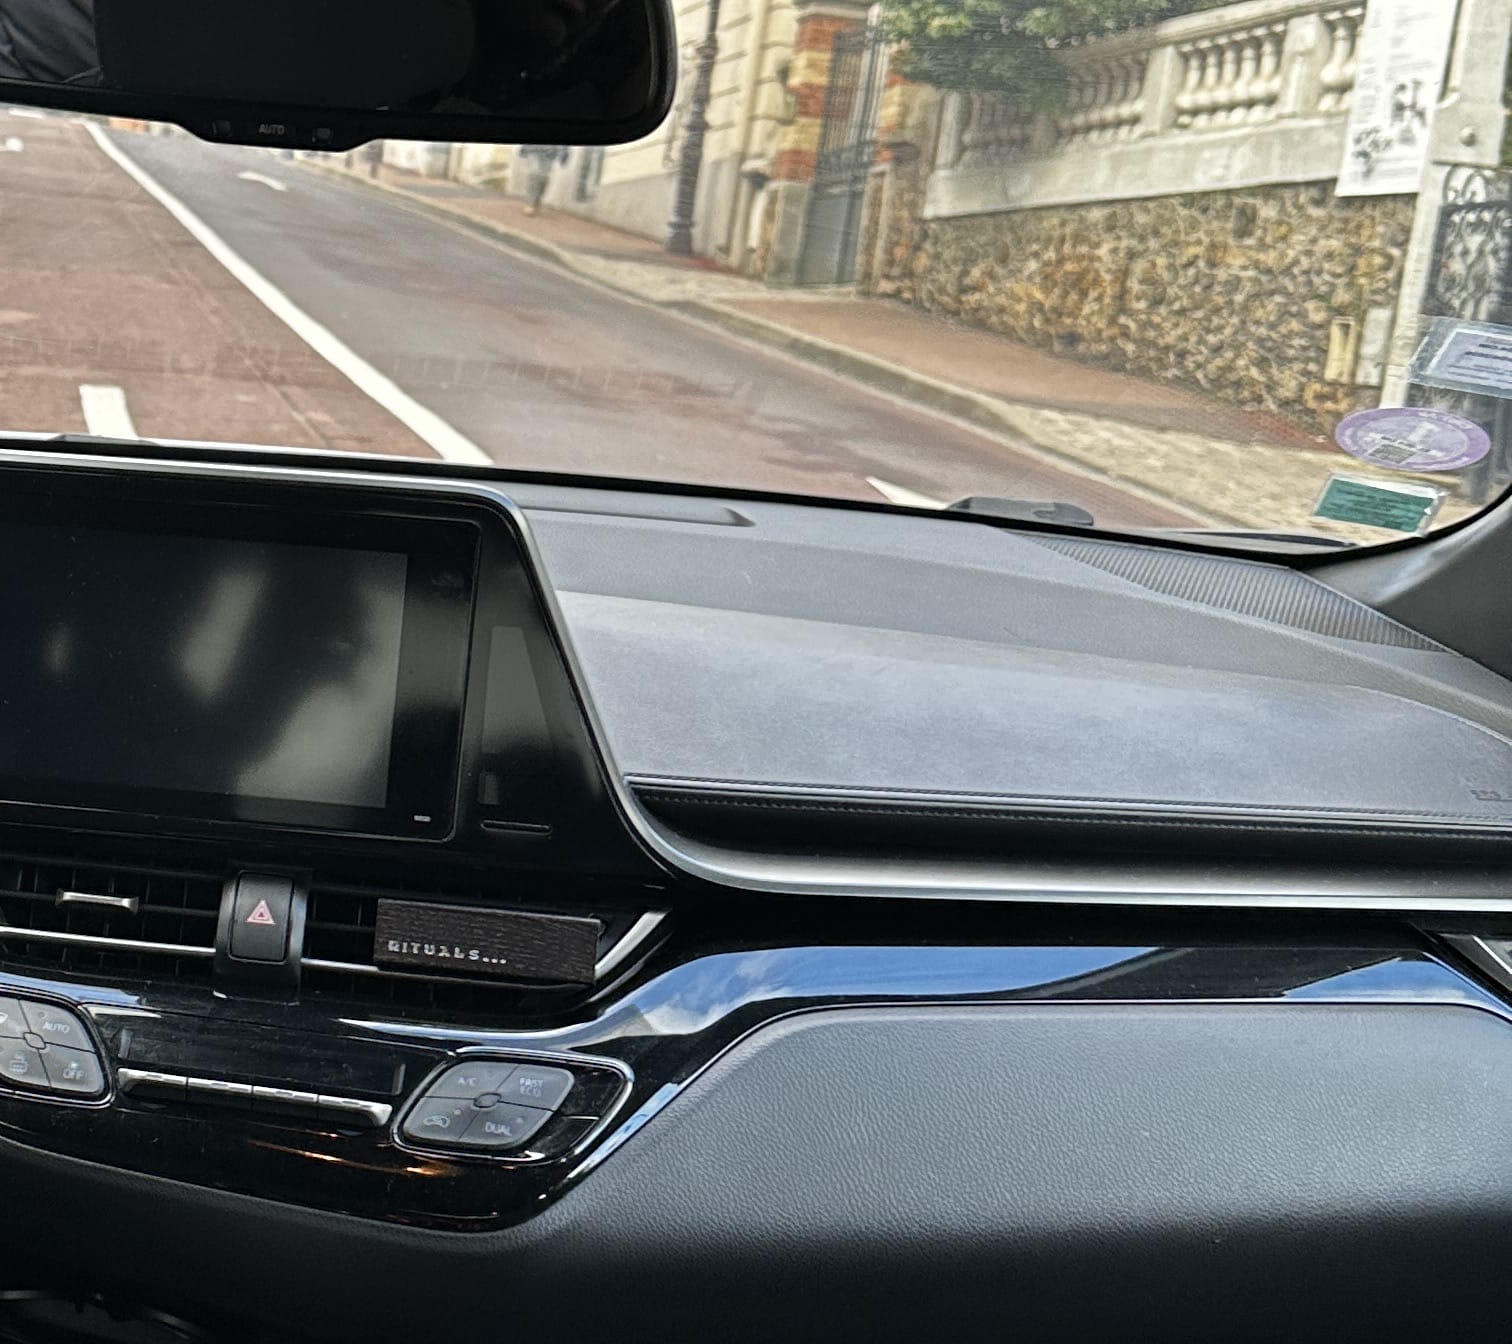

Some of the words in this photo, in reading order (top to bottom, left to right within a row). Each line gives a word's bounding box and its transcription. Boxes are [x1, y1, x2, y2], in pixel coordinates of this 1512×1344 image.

[258, 124, 285, 135] AUTO
[43, 1021, 71, 1034] AUTO
[63, 1068, 85, 1080] OFF
[457, 1076, 478, 1087] A/C
[519, 1077, 544, 1088] FAST
[485, 1121, 512, 1137] DUAL
